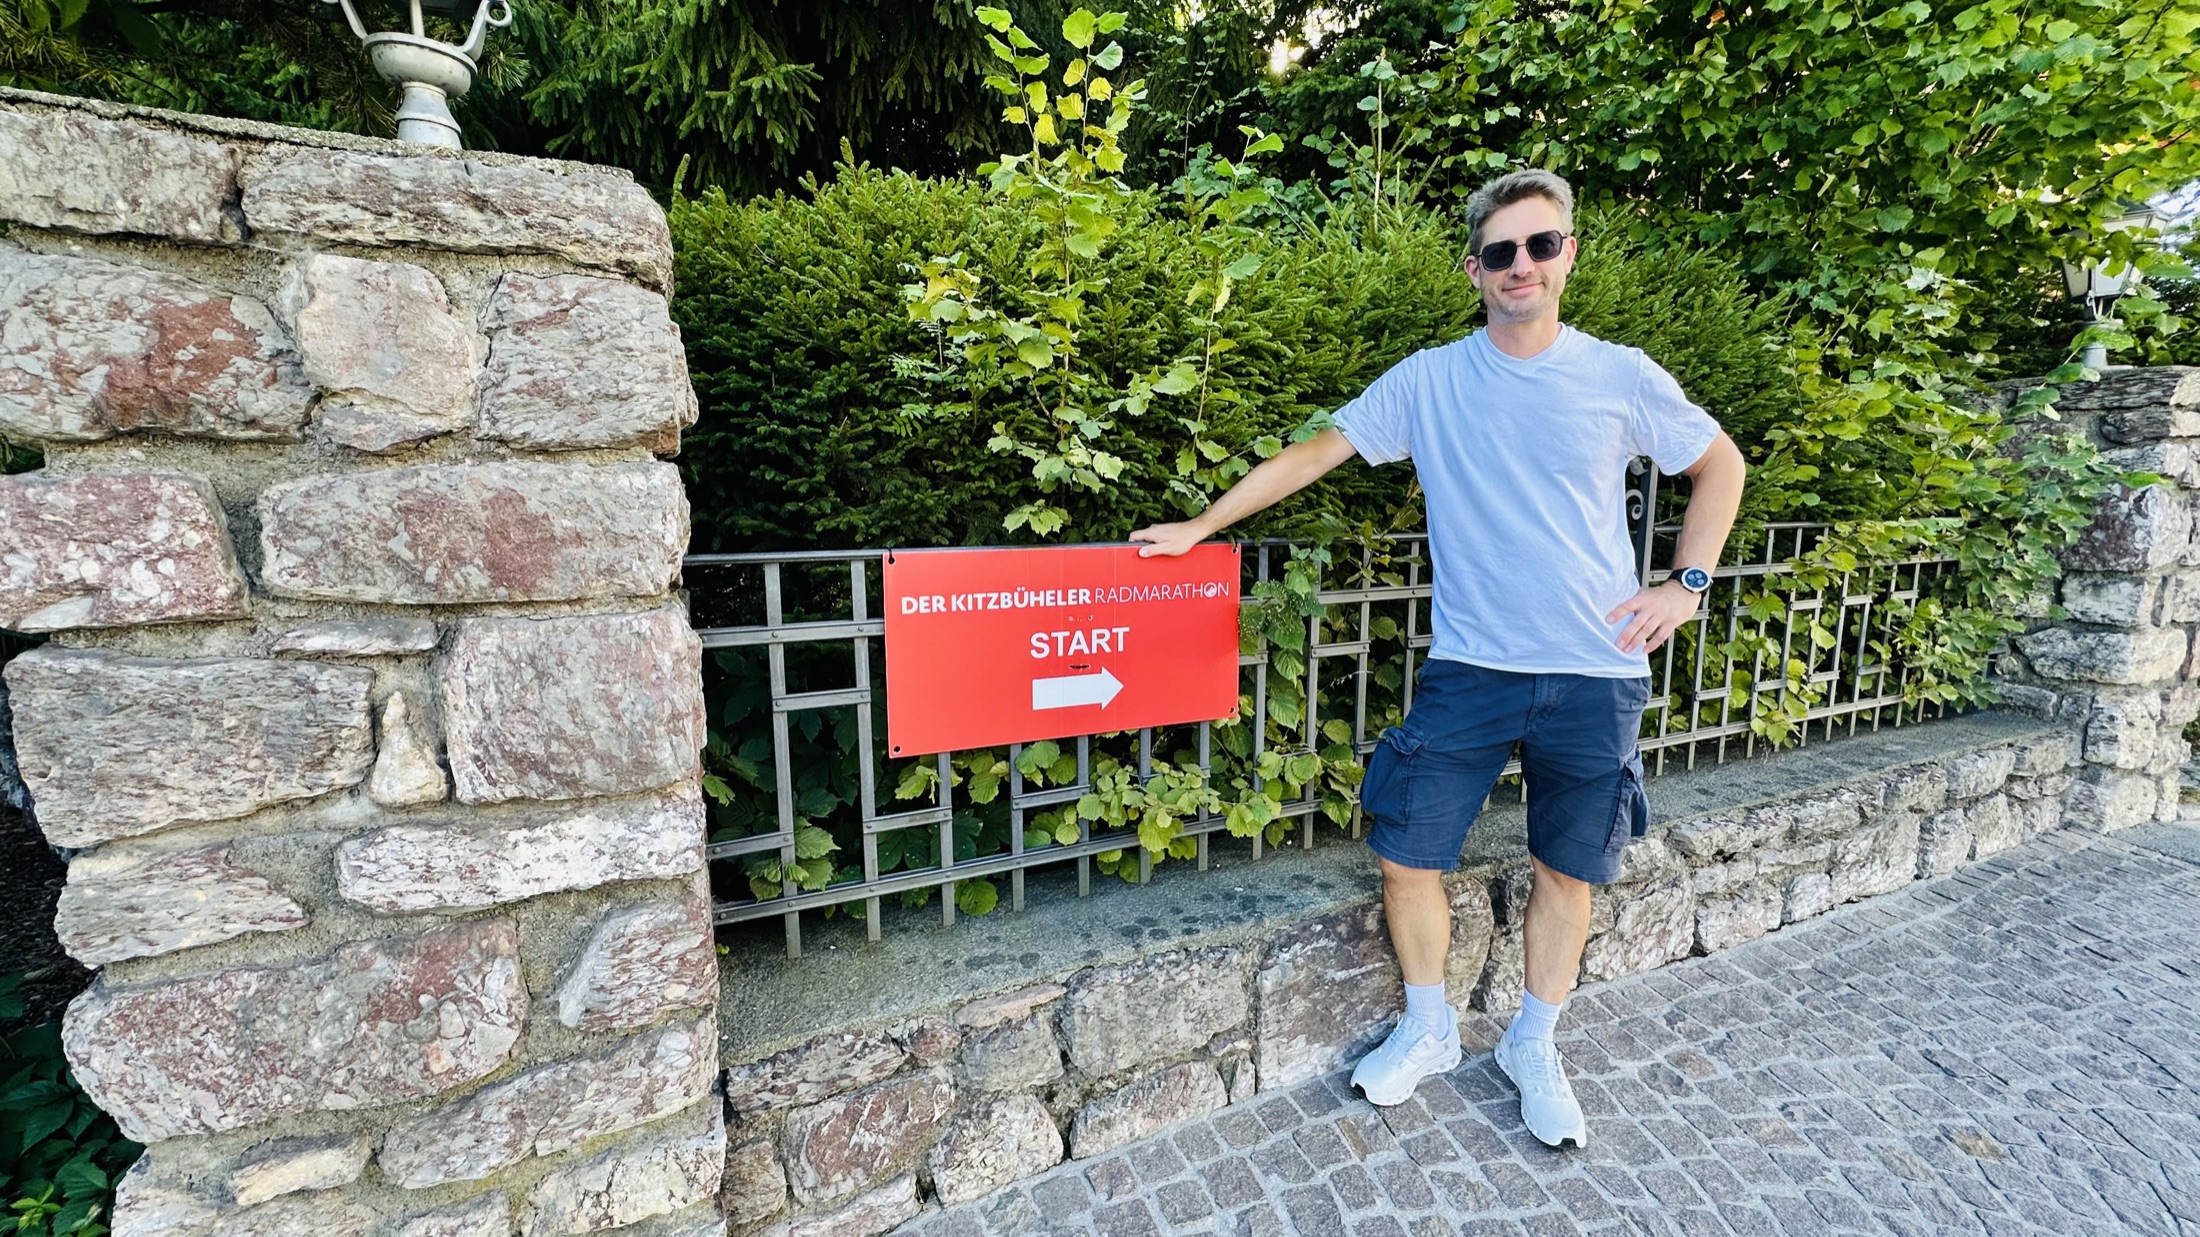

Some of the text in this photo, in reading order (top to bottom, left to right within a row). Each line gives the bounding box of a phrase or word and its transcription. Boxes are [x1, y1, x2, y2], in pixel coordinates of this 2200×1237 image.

[901, 581, 1229, 615] DER KITZBÜHELER RADMARATHON
[1030, 627, 1130, 658] START
